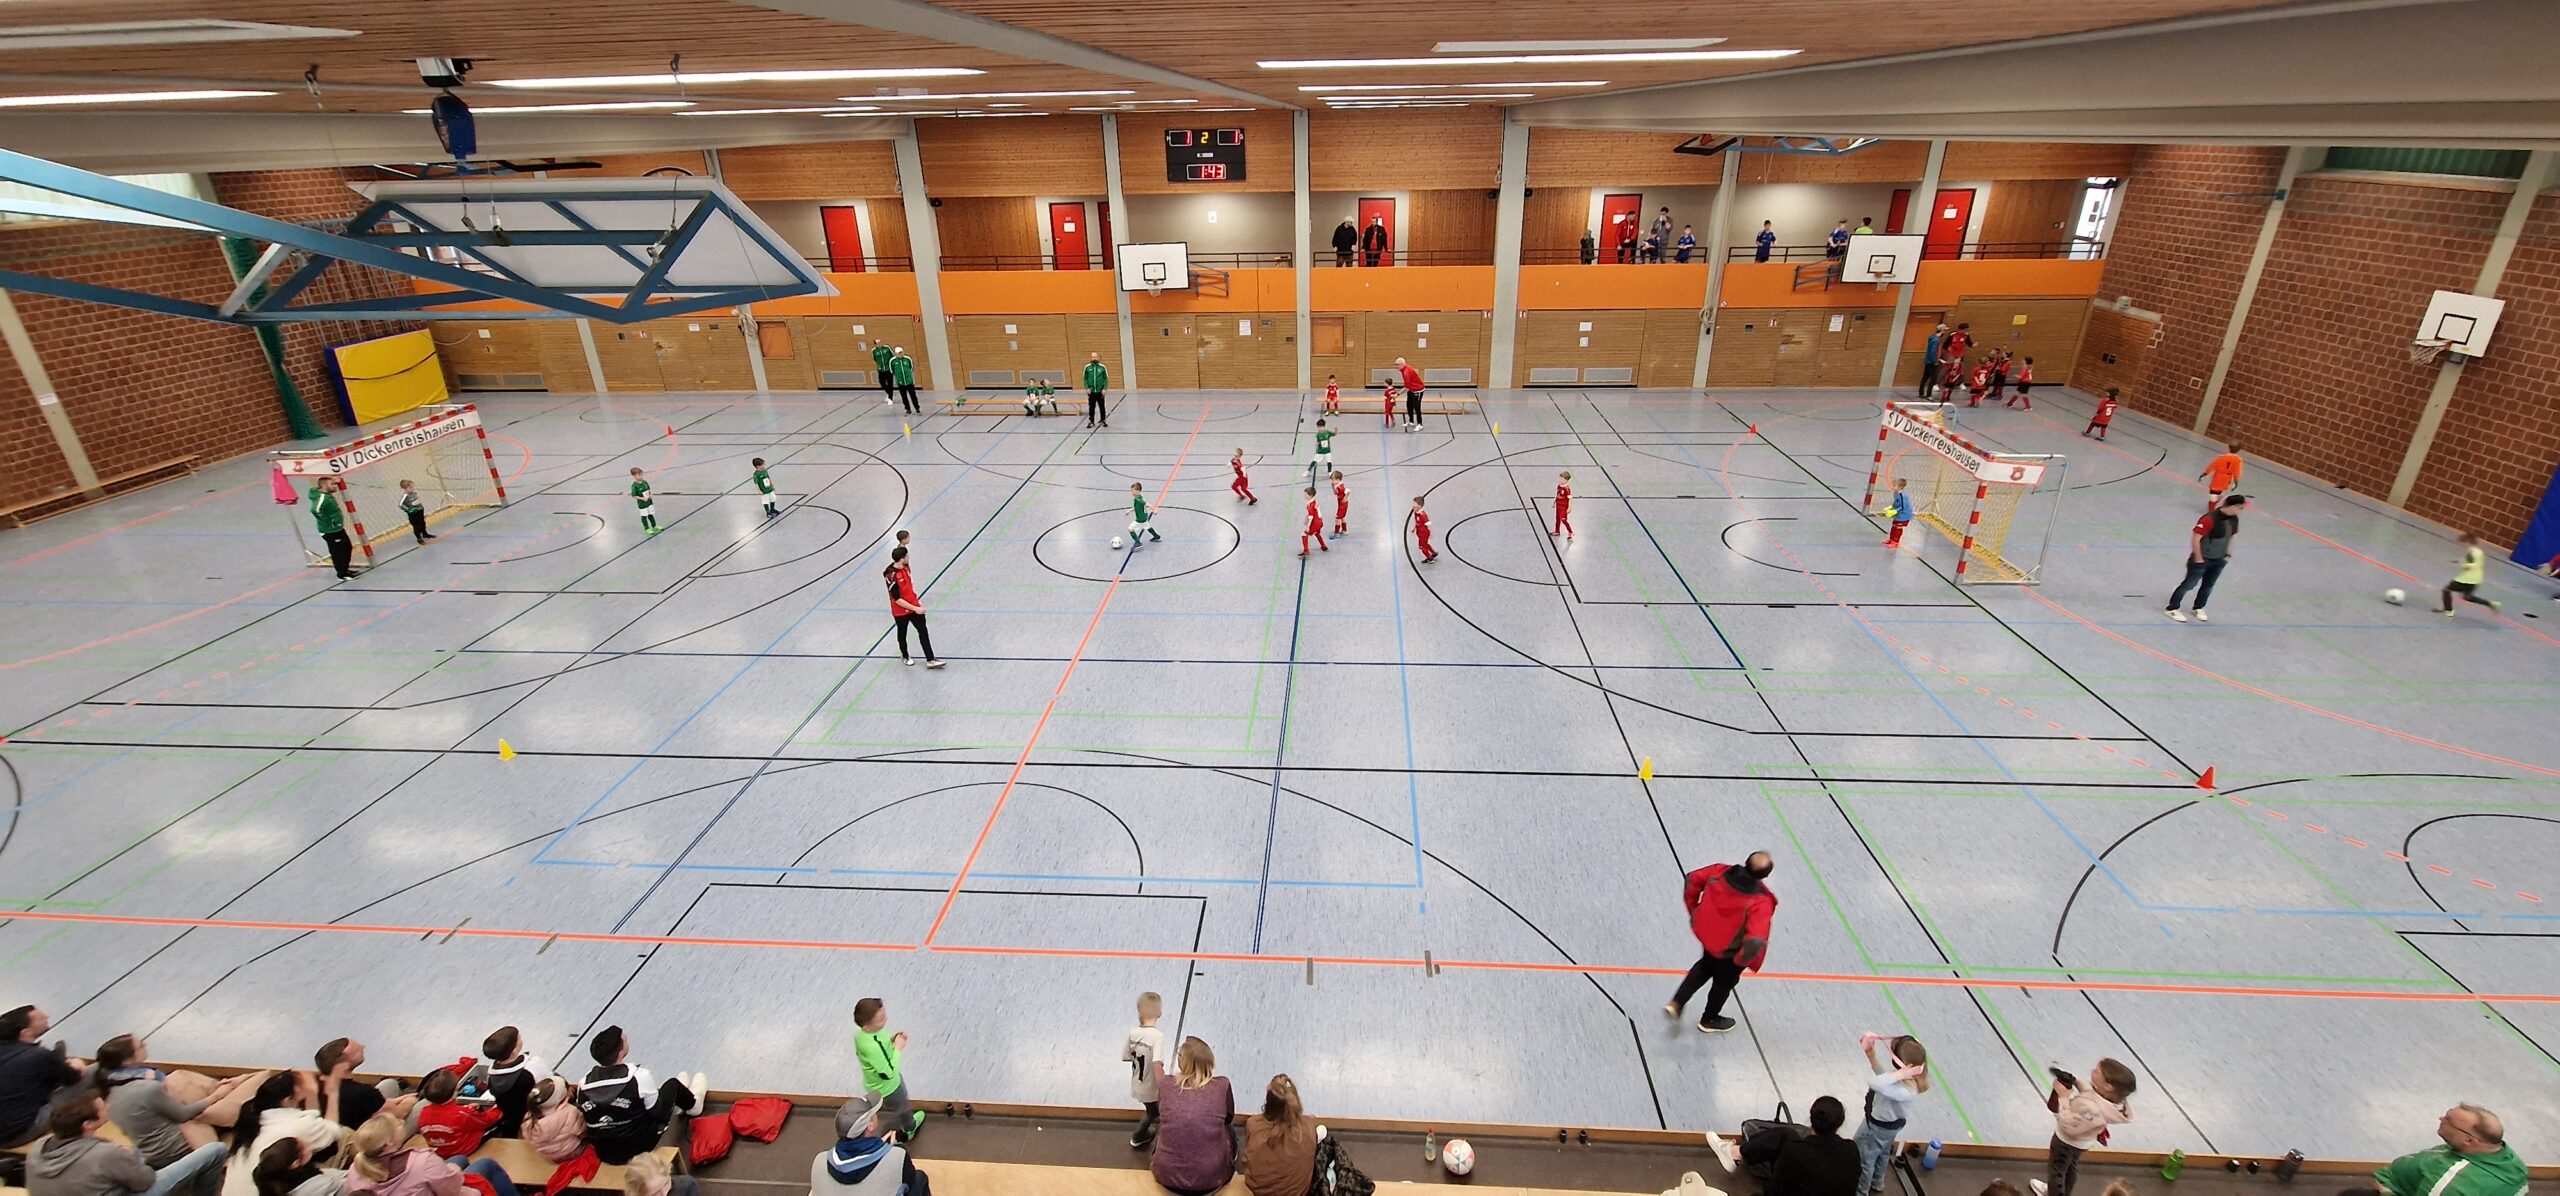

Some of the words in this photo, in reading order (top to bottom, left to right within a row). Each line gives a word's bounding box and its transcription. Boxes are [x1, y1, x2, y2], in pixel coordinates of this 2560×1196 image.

[1201, 131, 1208, 143] 2
[1200, 164, 1224, 179] 1:43
[1888, 411, 1903, 428] SV
[329, 449, 351, 474] SV
[352, 416, 466, 466] Dickenreishausen
